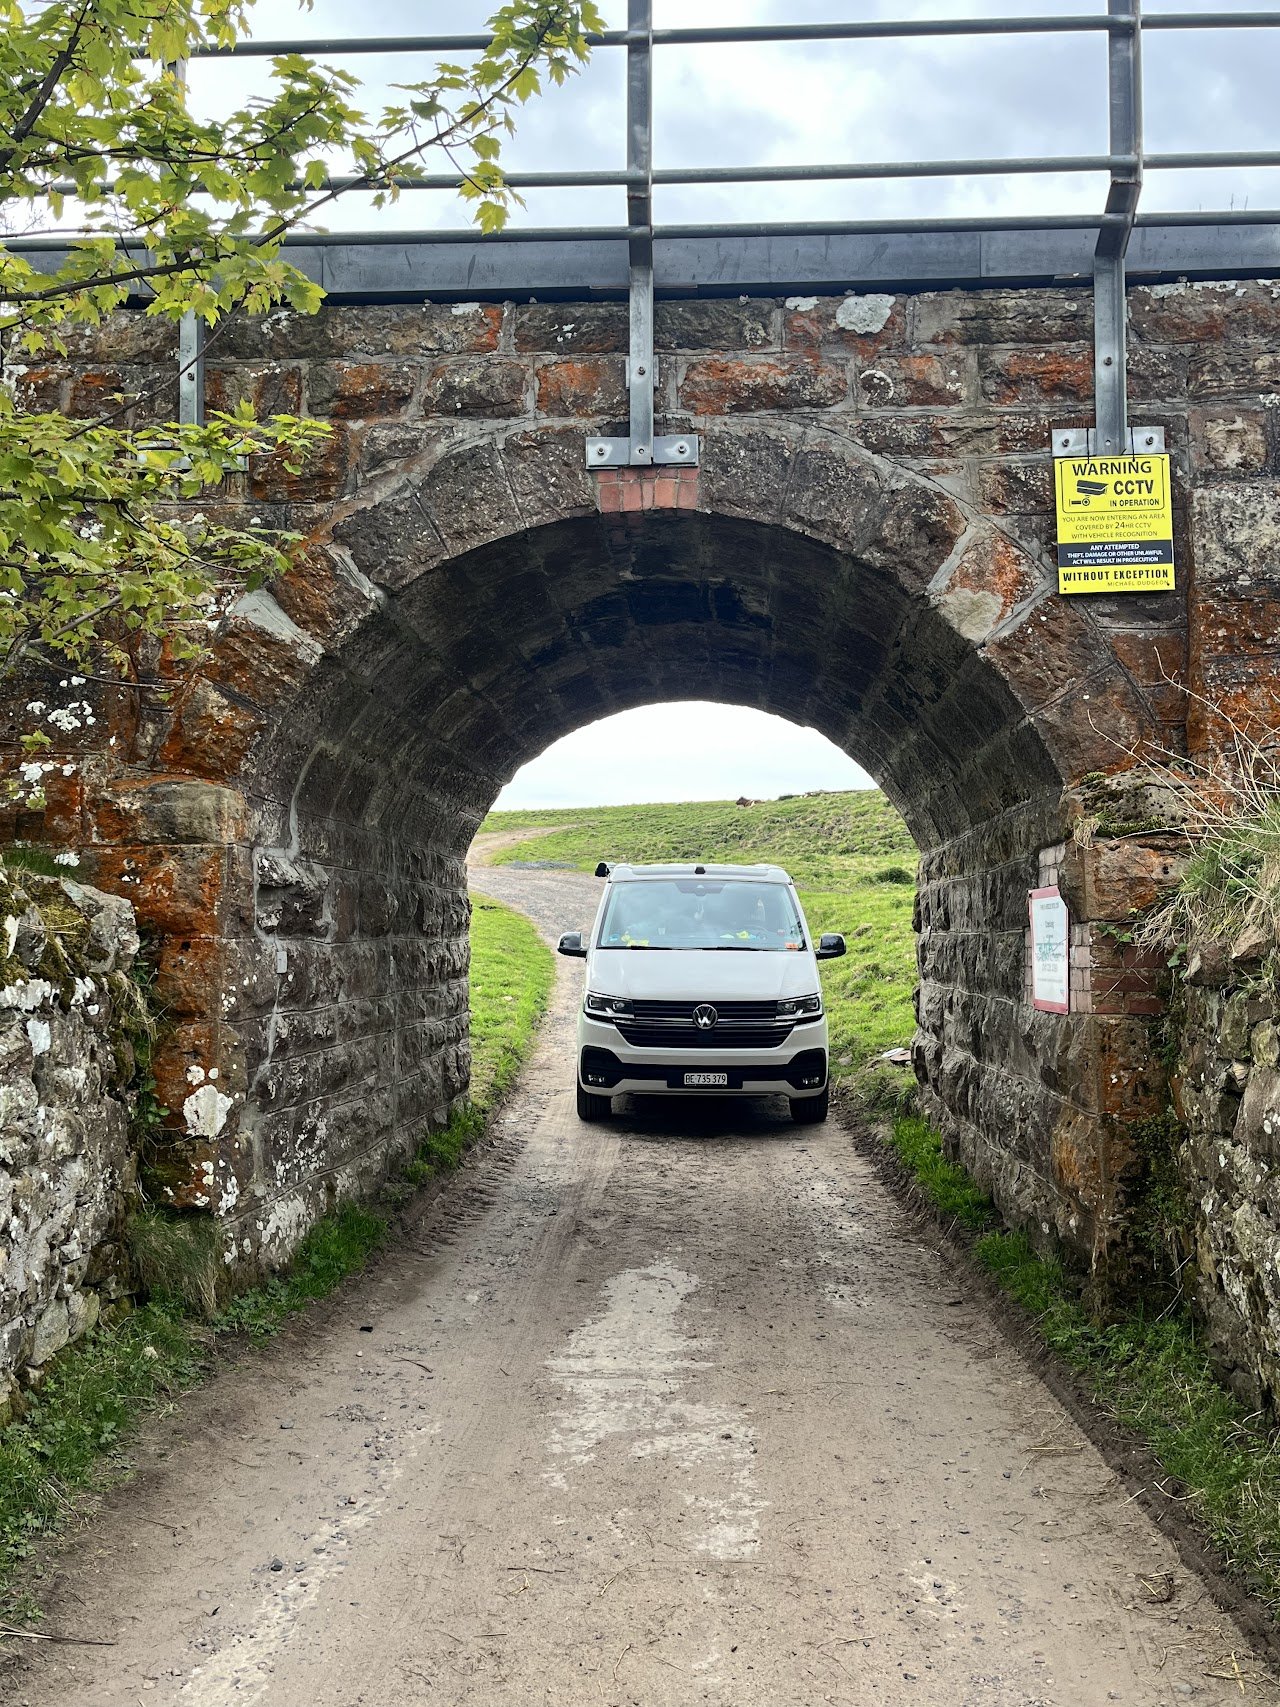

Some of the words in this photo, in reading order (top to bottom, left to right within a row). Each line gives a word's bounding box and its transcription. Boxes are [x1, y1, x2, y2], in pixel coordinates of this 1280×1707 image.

[1072, 461, 1152, 476] WARNING
[1114, 480, 1154, 495] CCTV
[1119, 498, 1160, 507] OPERATION
[1115, 530, 1158, 538] RECOGNITION
[1063, 571, 1110, 581] WITHOUT
[1114, 569, 1168, 580] EXCEPTION
